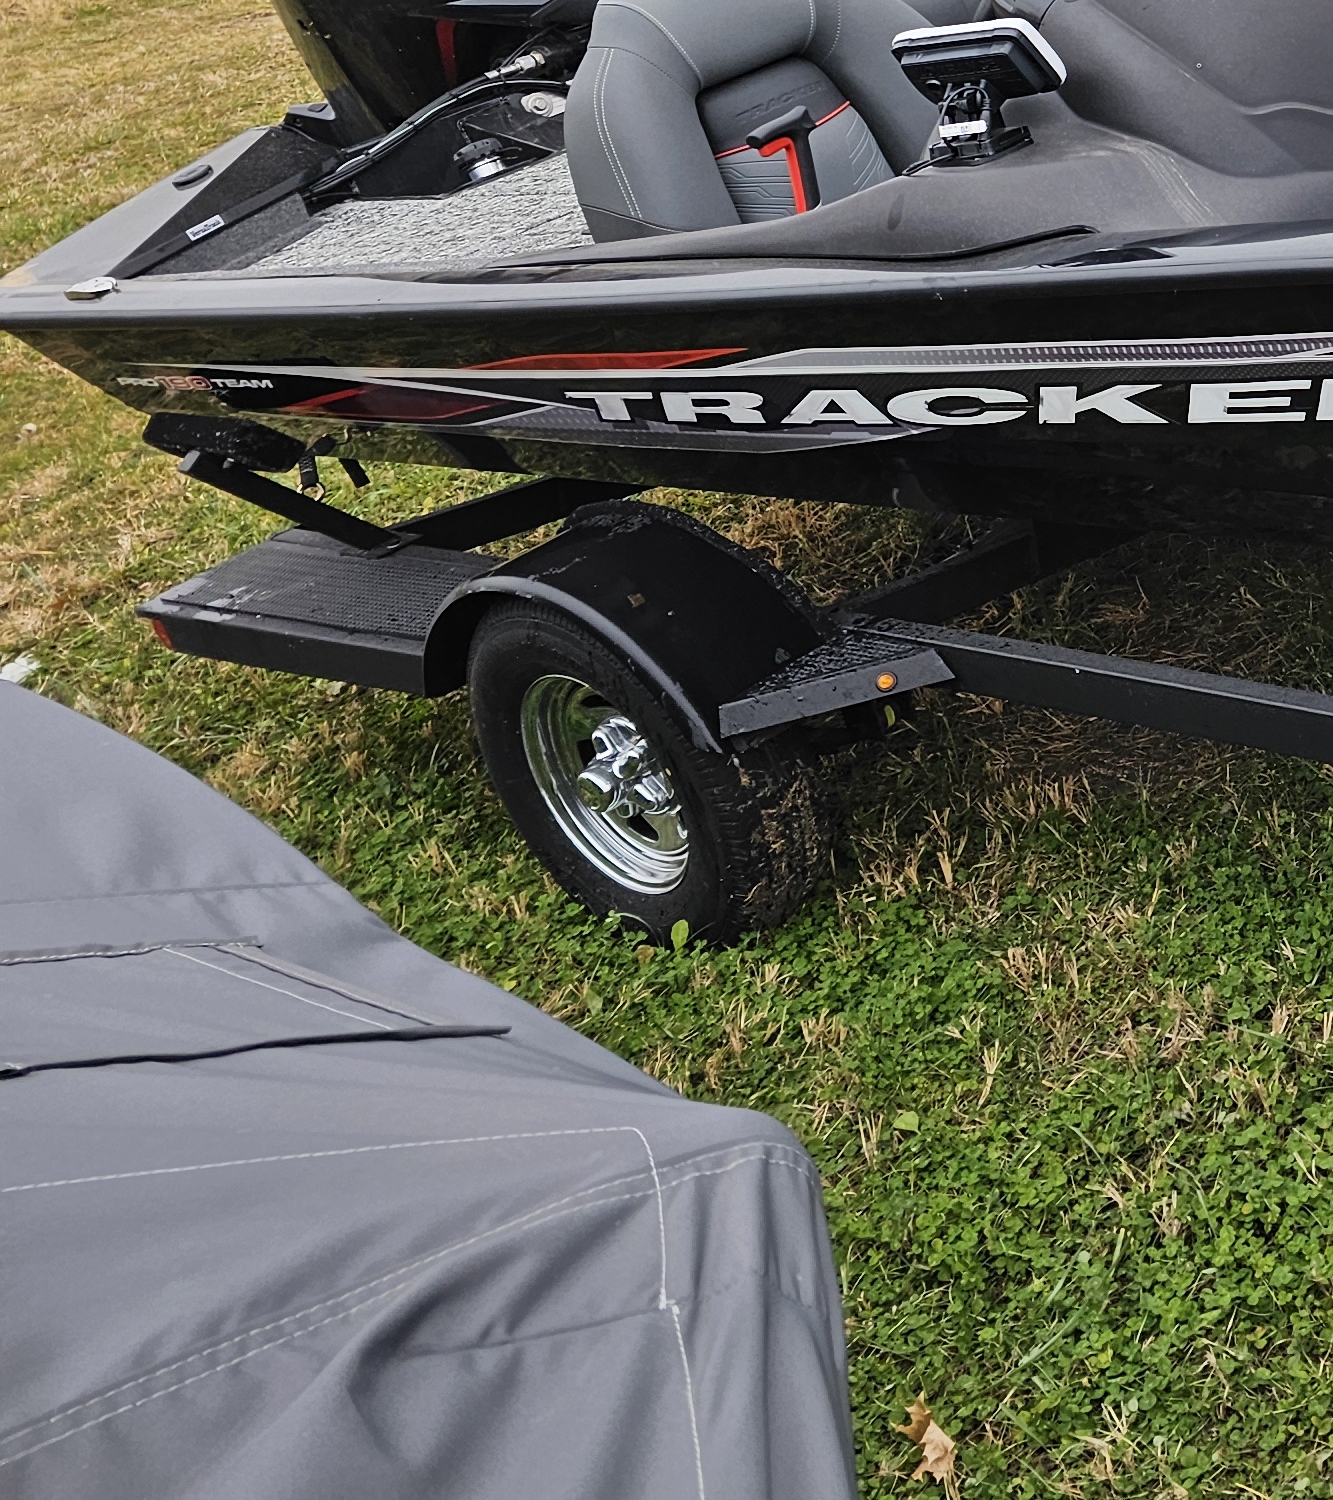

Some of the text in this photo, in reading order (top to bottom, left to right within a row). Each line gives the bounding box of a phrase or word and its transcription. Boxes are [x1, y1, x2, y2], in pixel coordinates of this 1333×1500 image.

[116, 376, 274, 391] PRO 190 TEAM
